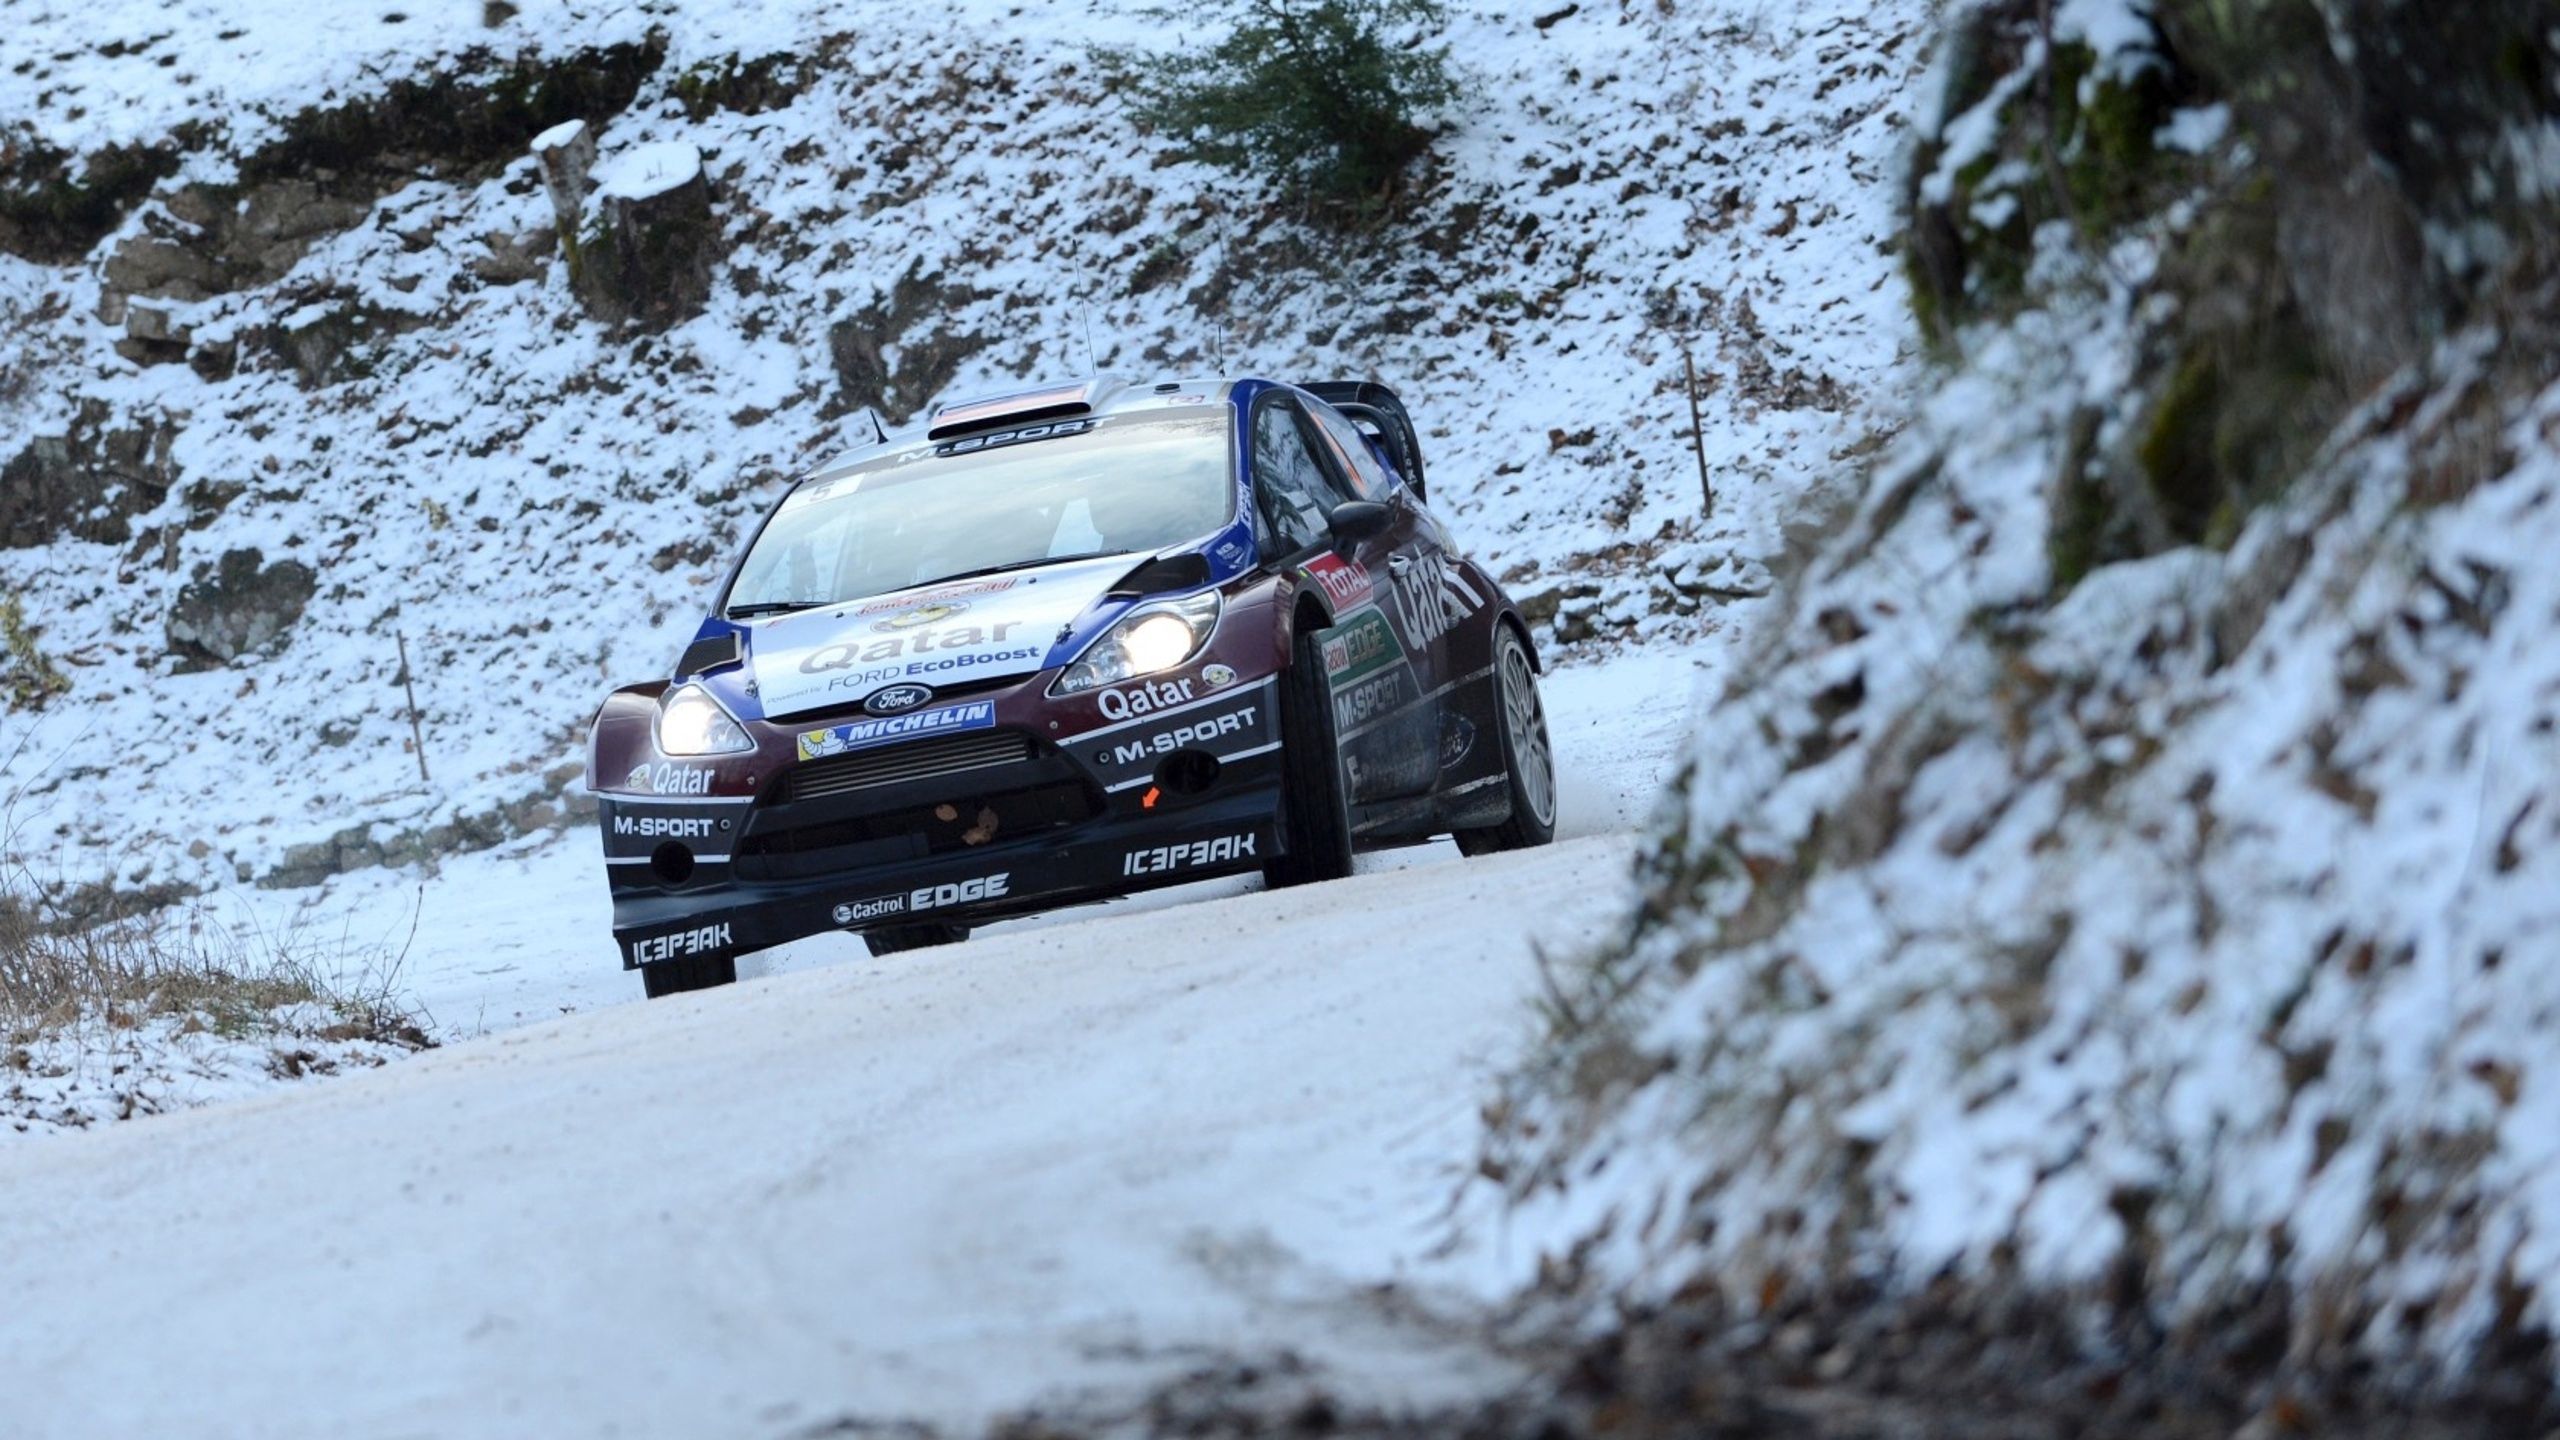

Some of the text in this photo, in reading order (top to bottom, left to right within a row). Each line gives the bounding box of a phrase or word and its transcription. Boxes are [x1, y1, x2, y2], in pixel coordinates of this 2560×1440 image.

[898, 417, 1116, 462] M-SPORT
[810, 485, 833, 501] 5
[1316, 563, 1370, 599] TOTAL
[799, 620, 1023, 674] Qatar
[1345, 621, 1385, 665] EDGE
[828, 667, 900, 691] FORD
[906, 646, 1040, 676] EcoBoost
[878, 690, 915, 709] Ford
[1098, 678, 1194, 720] Qatar
[1337, 672, 1400, 728] M-SPORT
[850, 704, 991, 739] MICHELIN
[1114, 707, 1257, 764] M-SPORT
[653, 763, 715, 794] Qatar
[614, 816, 713, 837] M-SPORT
[853, 872, 1010, 920] Castrol EDGE
